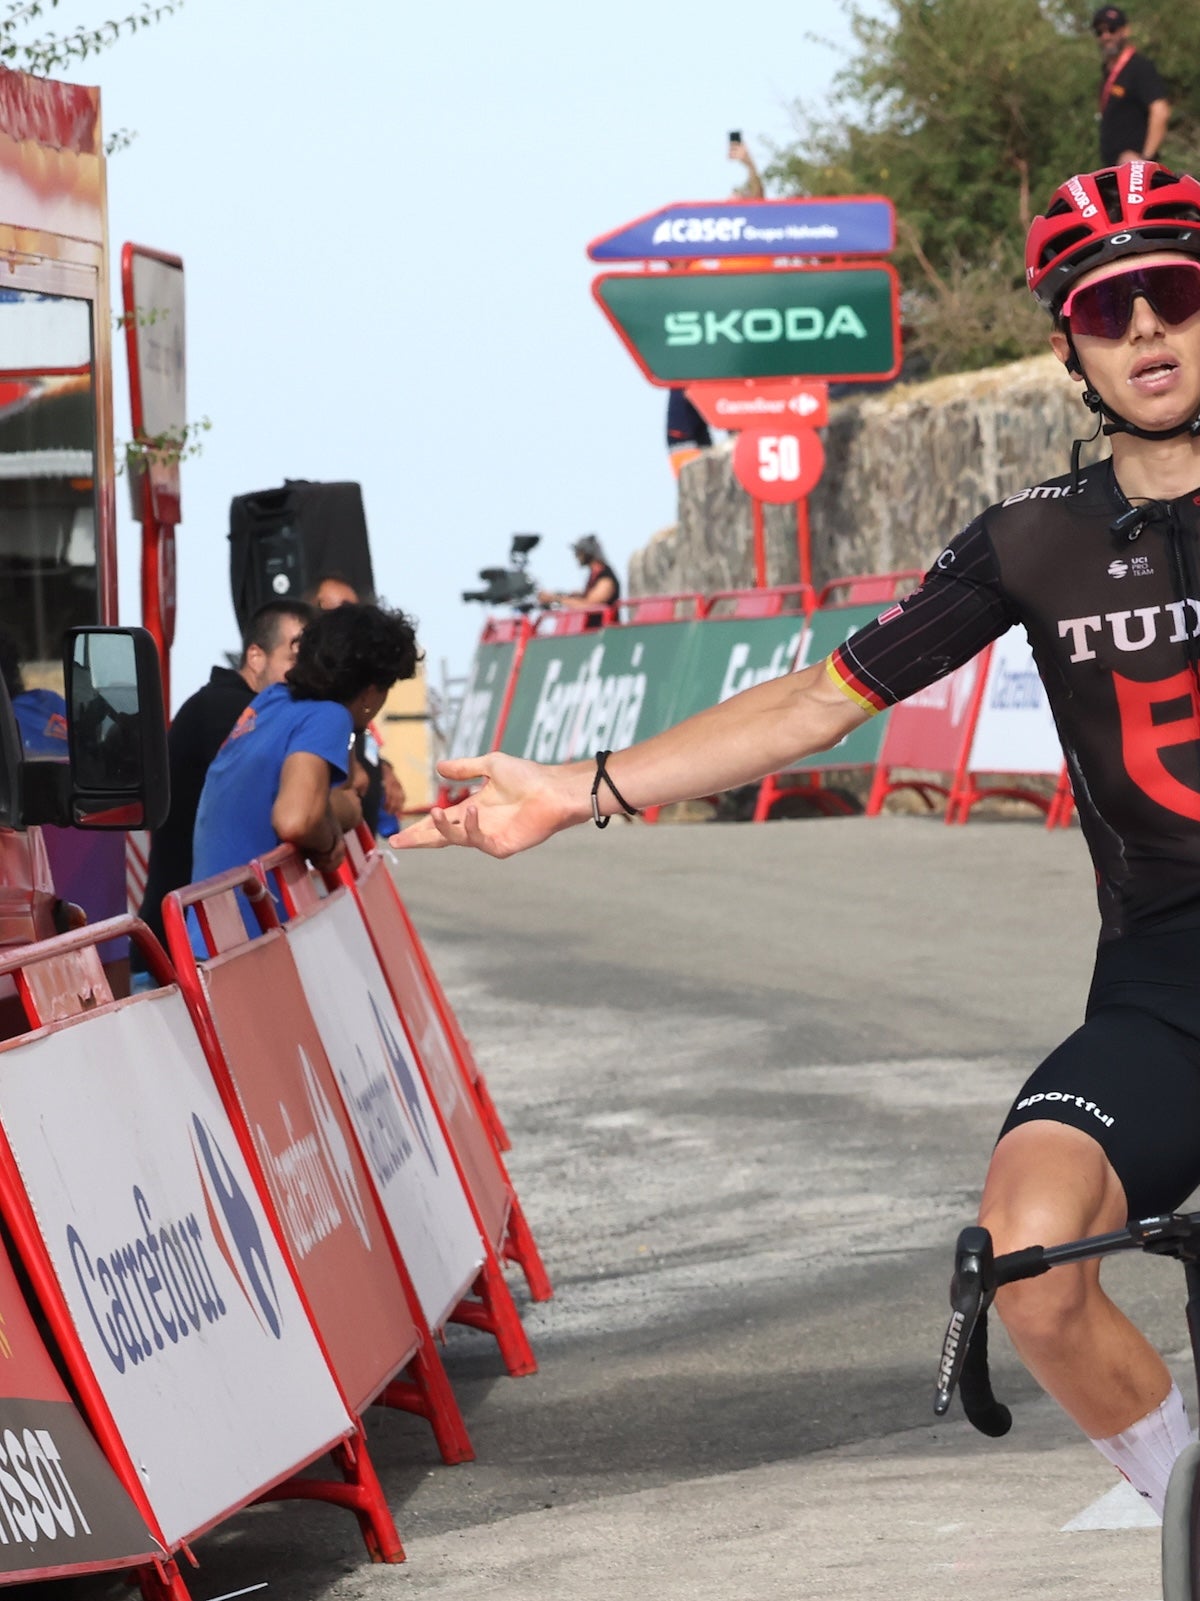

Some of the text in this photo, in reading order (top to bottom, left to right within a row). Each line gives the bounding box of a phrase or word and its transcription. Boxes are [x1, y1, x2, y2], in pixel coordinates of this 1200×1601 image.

[758, 434, 801, 482] 50
[1131, 556, 1148, 564] UCI
[1133, 568, 1154, 577] TEAM
[1016, 1092, 1115, 1128] sportful
[66, 1185, 226, 1375] Carrefour
[937, 1310, 966, 1390] SRAM
